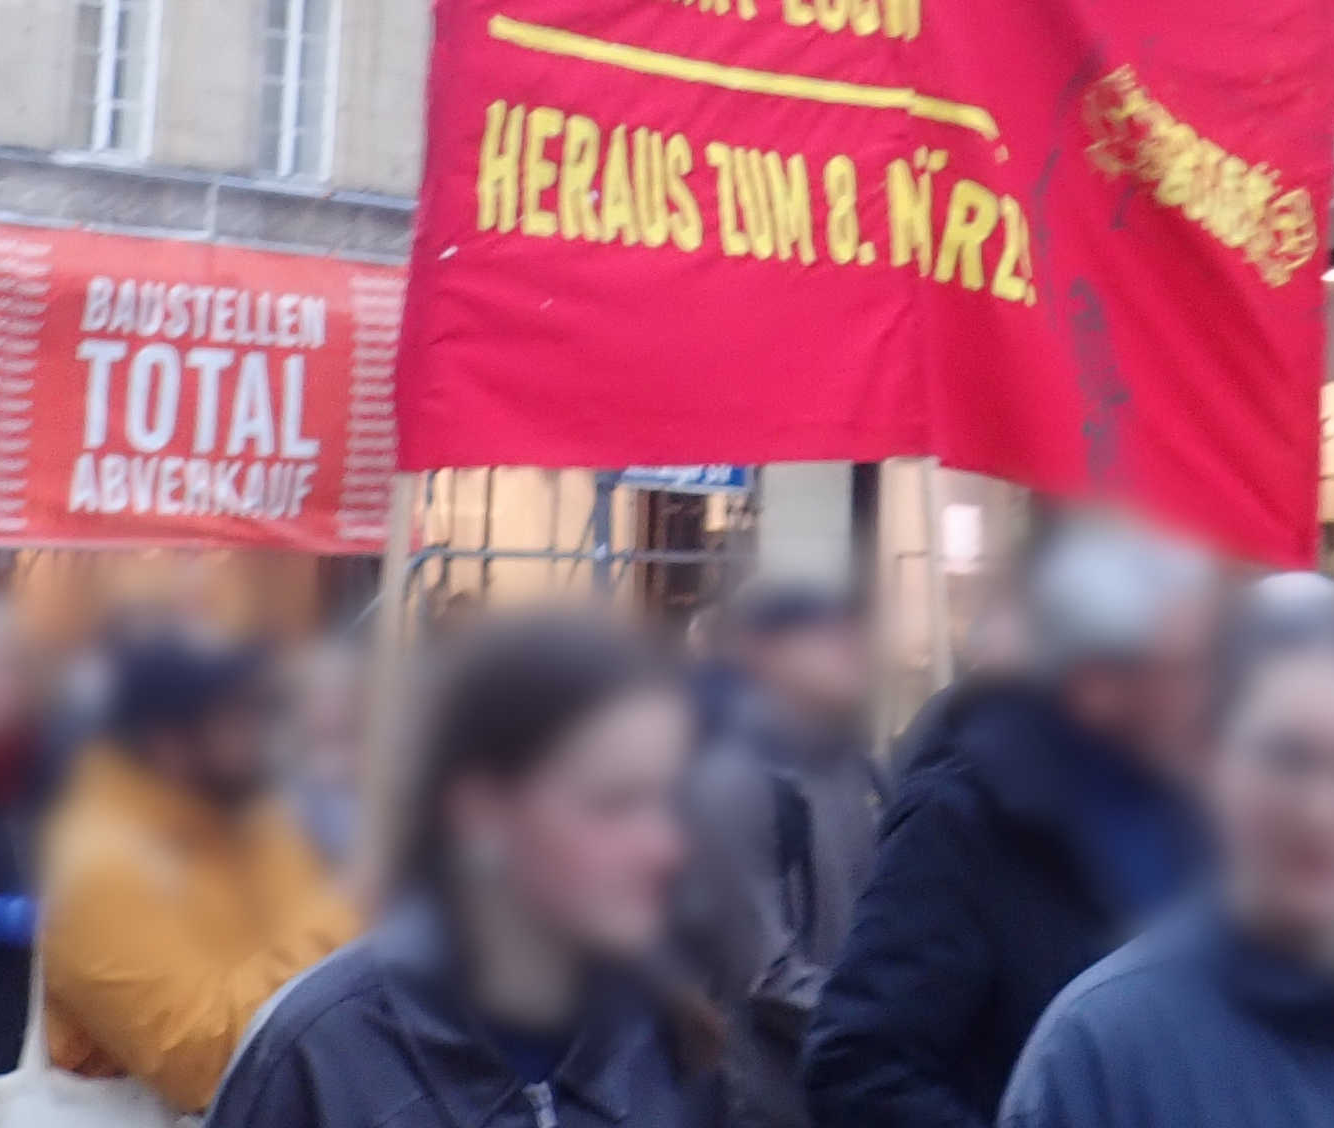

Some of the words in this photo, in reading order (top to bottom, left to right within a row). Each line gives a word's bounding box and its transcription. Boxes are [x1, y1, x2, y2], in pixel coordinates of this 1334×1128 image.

[477, 99, 703, 253] HERAUS
[706, 141, 816, 266] ZUM
[822, 154, 877, 265] 8.
[78, 274, 327, 349] BAUSTELLEN
[75, 338, 321, 460] TOTAL
[68, 452, 318, 520] ABVERKAUF
